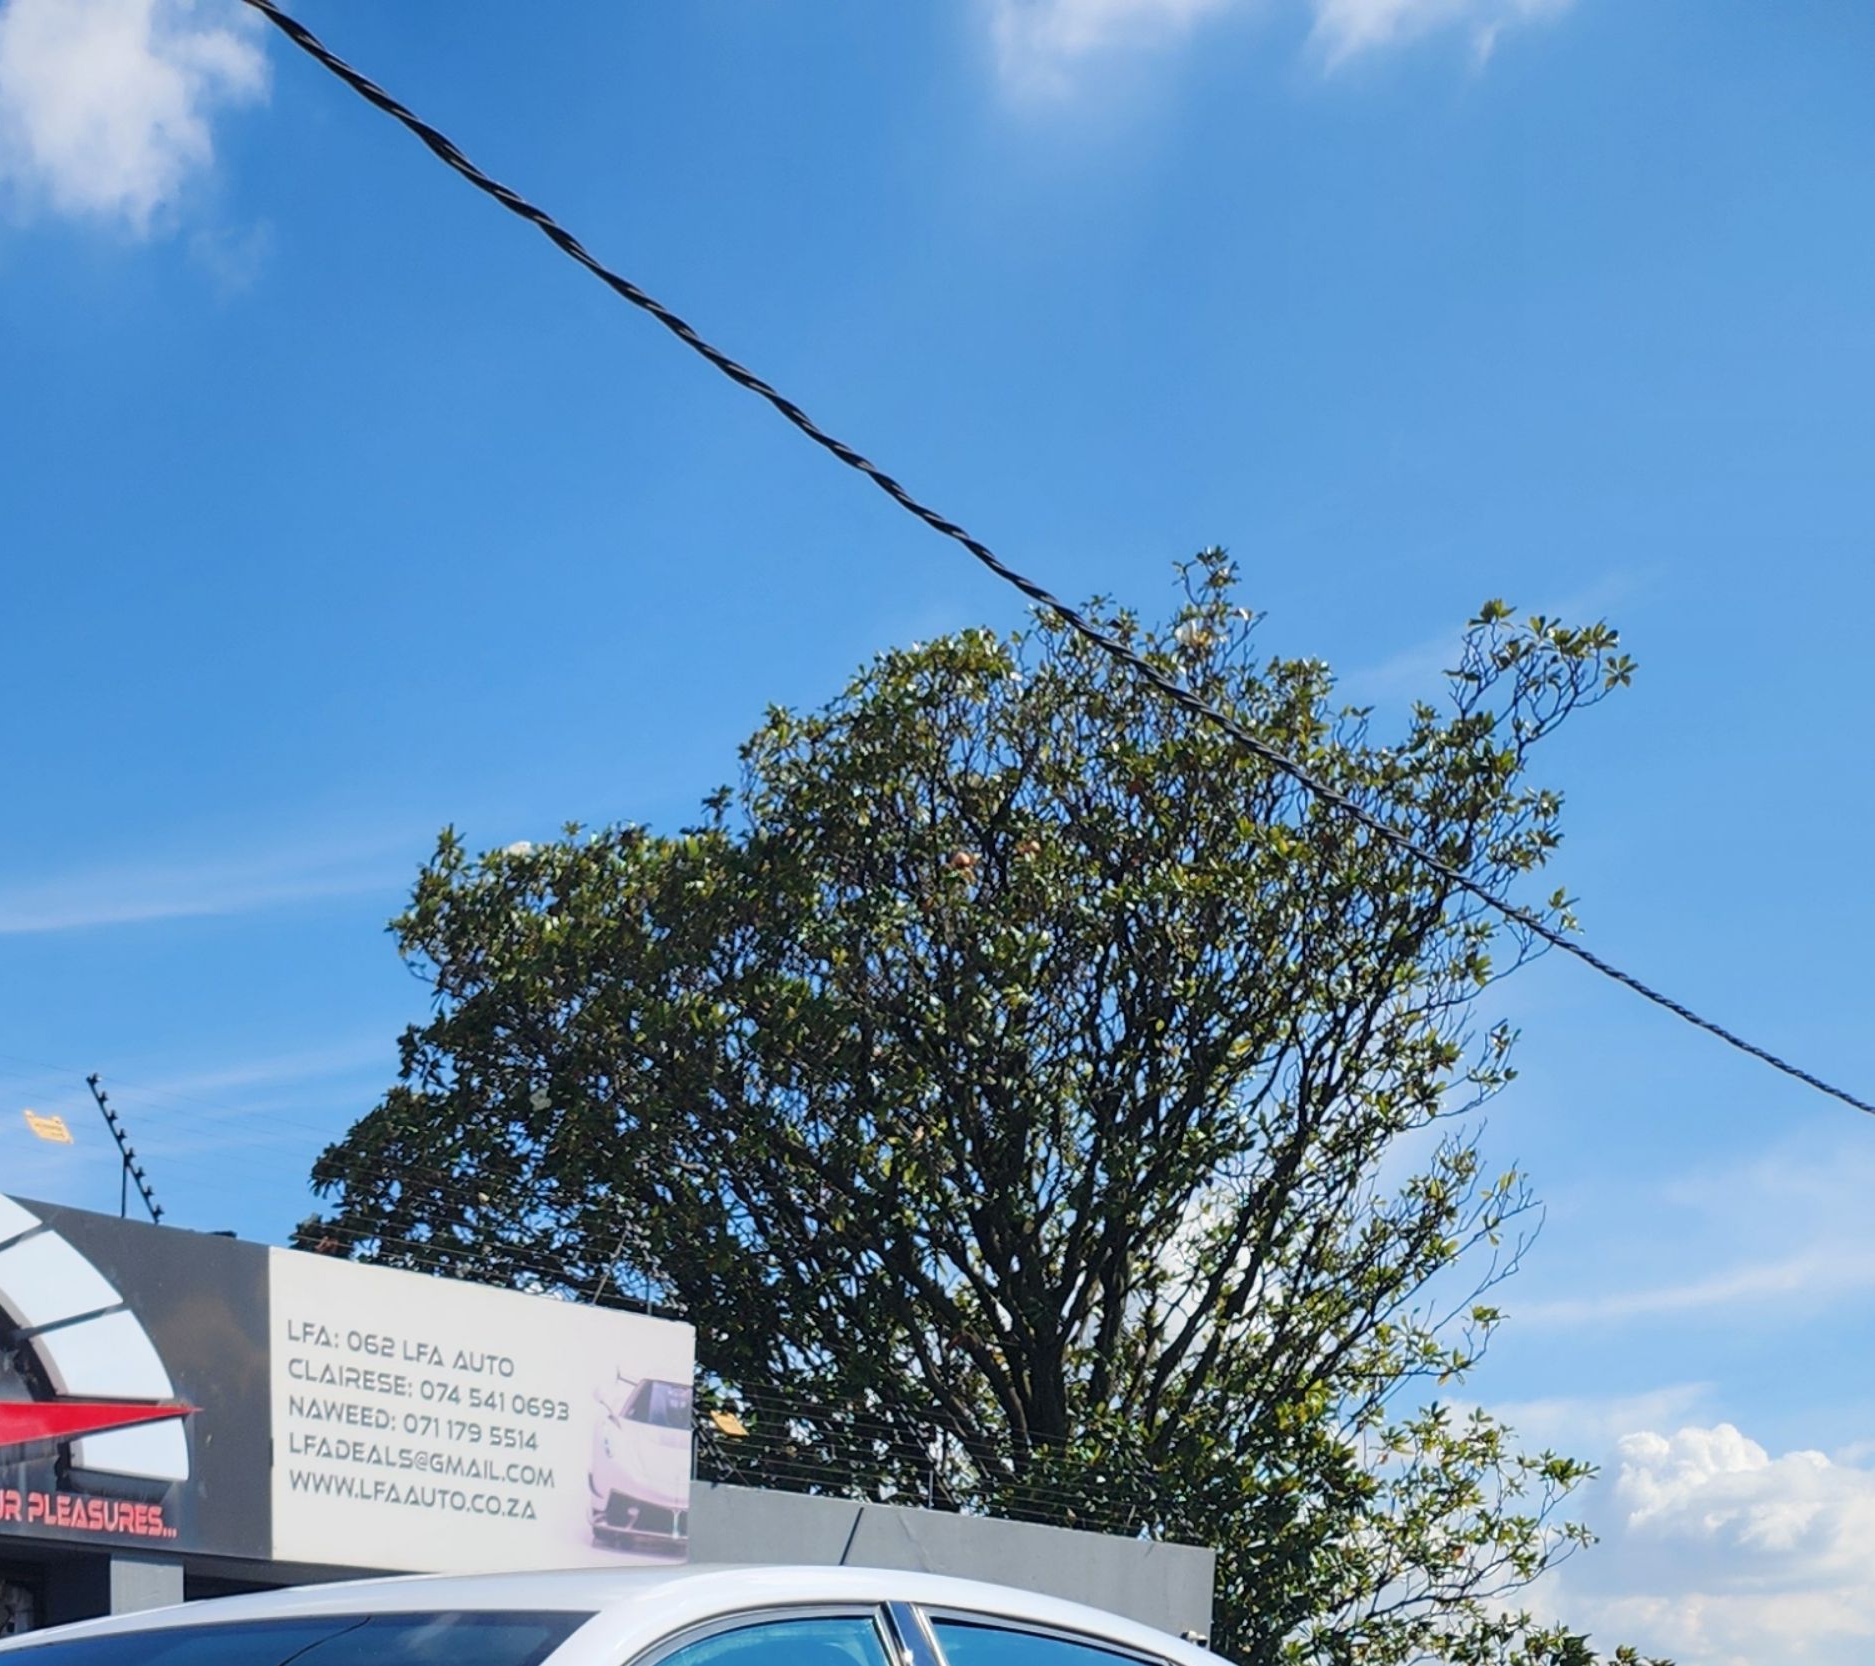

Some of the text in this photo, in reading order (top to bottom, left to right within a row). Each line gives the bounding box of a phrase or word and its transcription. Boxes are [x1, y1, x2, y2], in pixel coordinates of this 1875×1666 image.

[287, 1318, 515, 1378] LFA: 062 LFA AUTO
[287, 1357, 570, 1422] CLAIRESE: 074 541 0693
[288, 1394, 539, 1452] NAWEED: 071 179 5514
[288, 1431, 556, 1489] LFADEALS@GMAIL.COM
[27, 1491, 178, 1540] PLEASURES...
[288, 1469, 538, 1521] WWW.LFAAUTO.CO.ZA
